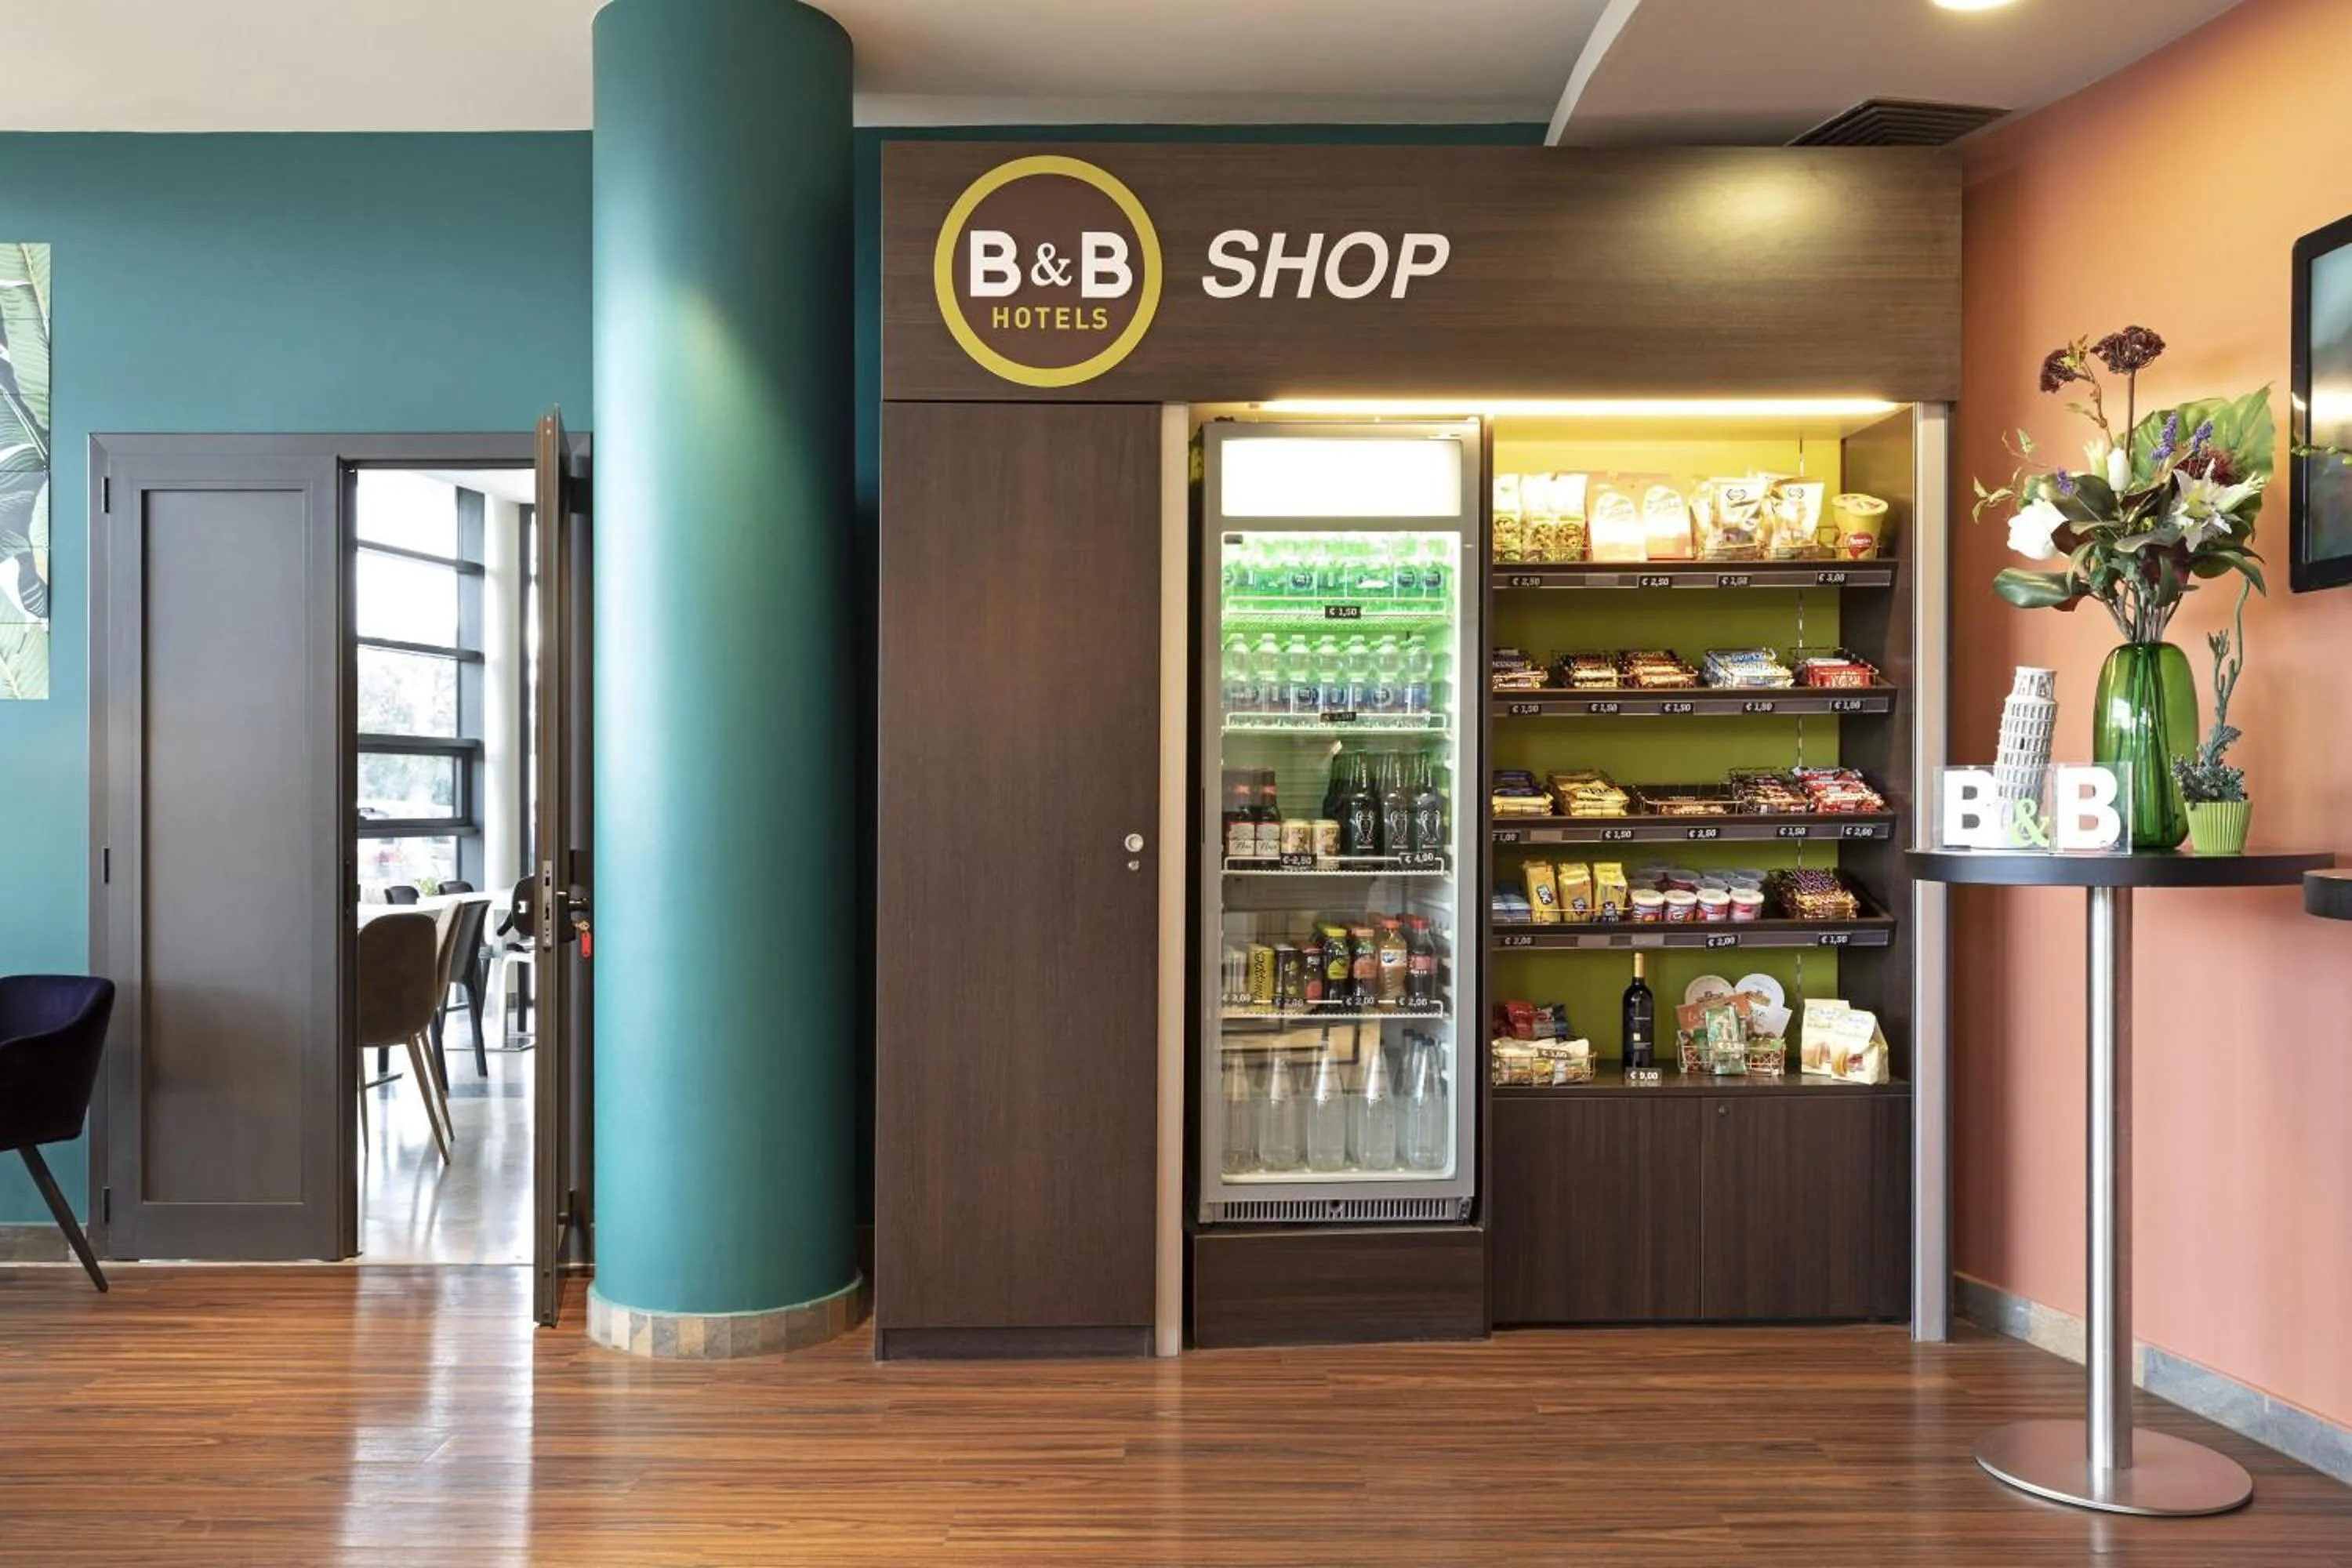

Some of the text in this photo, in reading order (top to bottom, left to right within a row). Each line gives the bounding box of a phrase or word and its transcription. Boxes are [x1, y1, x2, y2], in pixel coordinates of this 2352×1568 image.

[970, 230, 1133, 299] B&B
[1202, 230, 1450, 299] SHOP
[992, 307, 1108, 330] HOTELS
[1338, 608, 1357, 617] 1,50
[1944, 767, 2121, 848] B&B
[1639, 1070, 1658, 1081] 9,00
